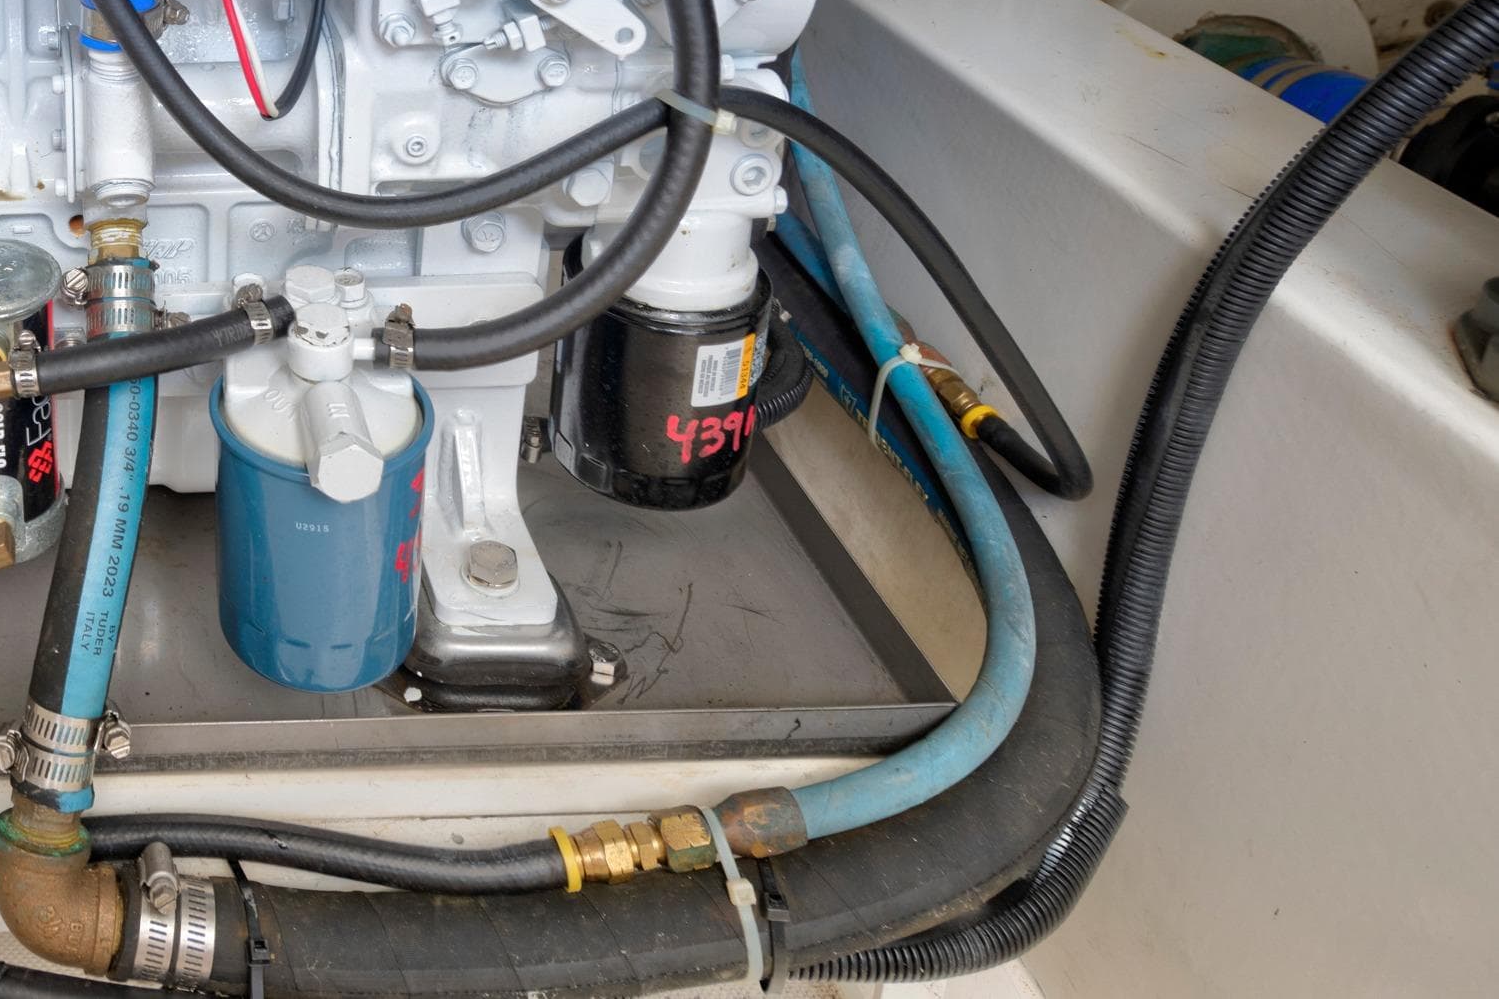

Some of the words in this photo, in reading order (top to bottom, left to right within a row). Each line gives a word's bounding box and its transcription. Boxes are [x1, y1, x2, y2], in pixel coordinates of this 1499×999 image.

[111, 517, 130, 550] MM
[102, 555, 121, 599] 2023
[81, 610, 95, 651] ITALY
[92, 610, 110, 657] TUDER
